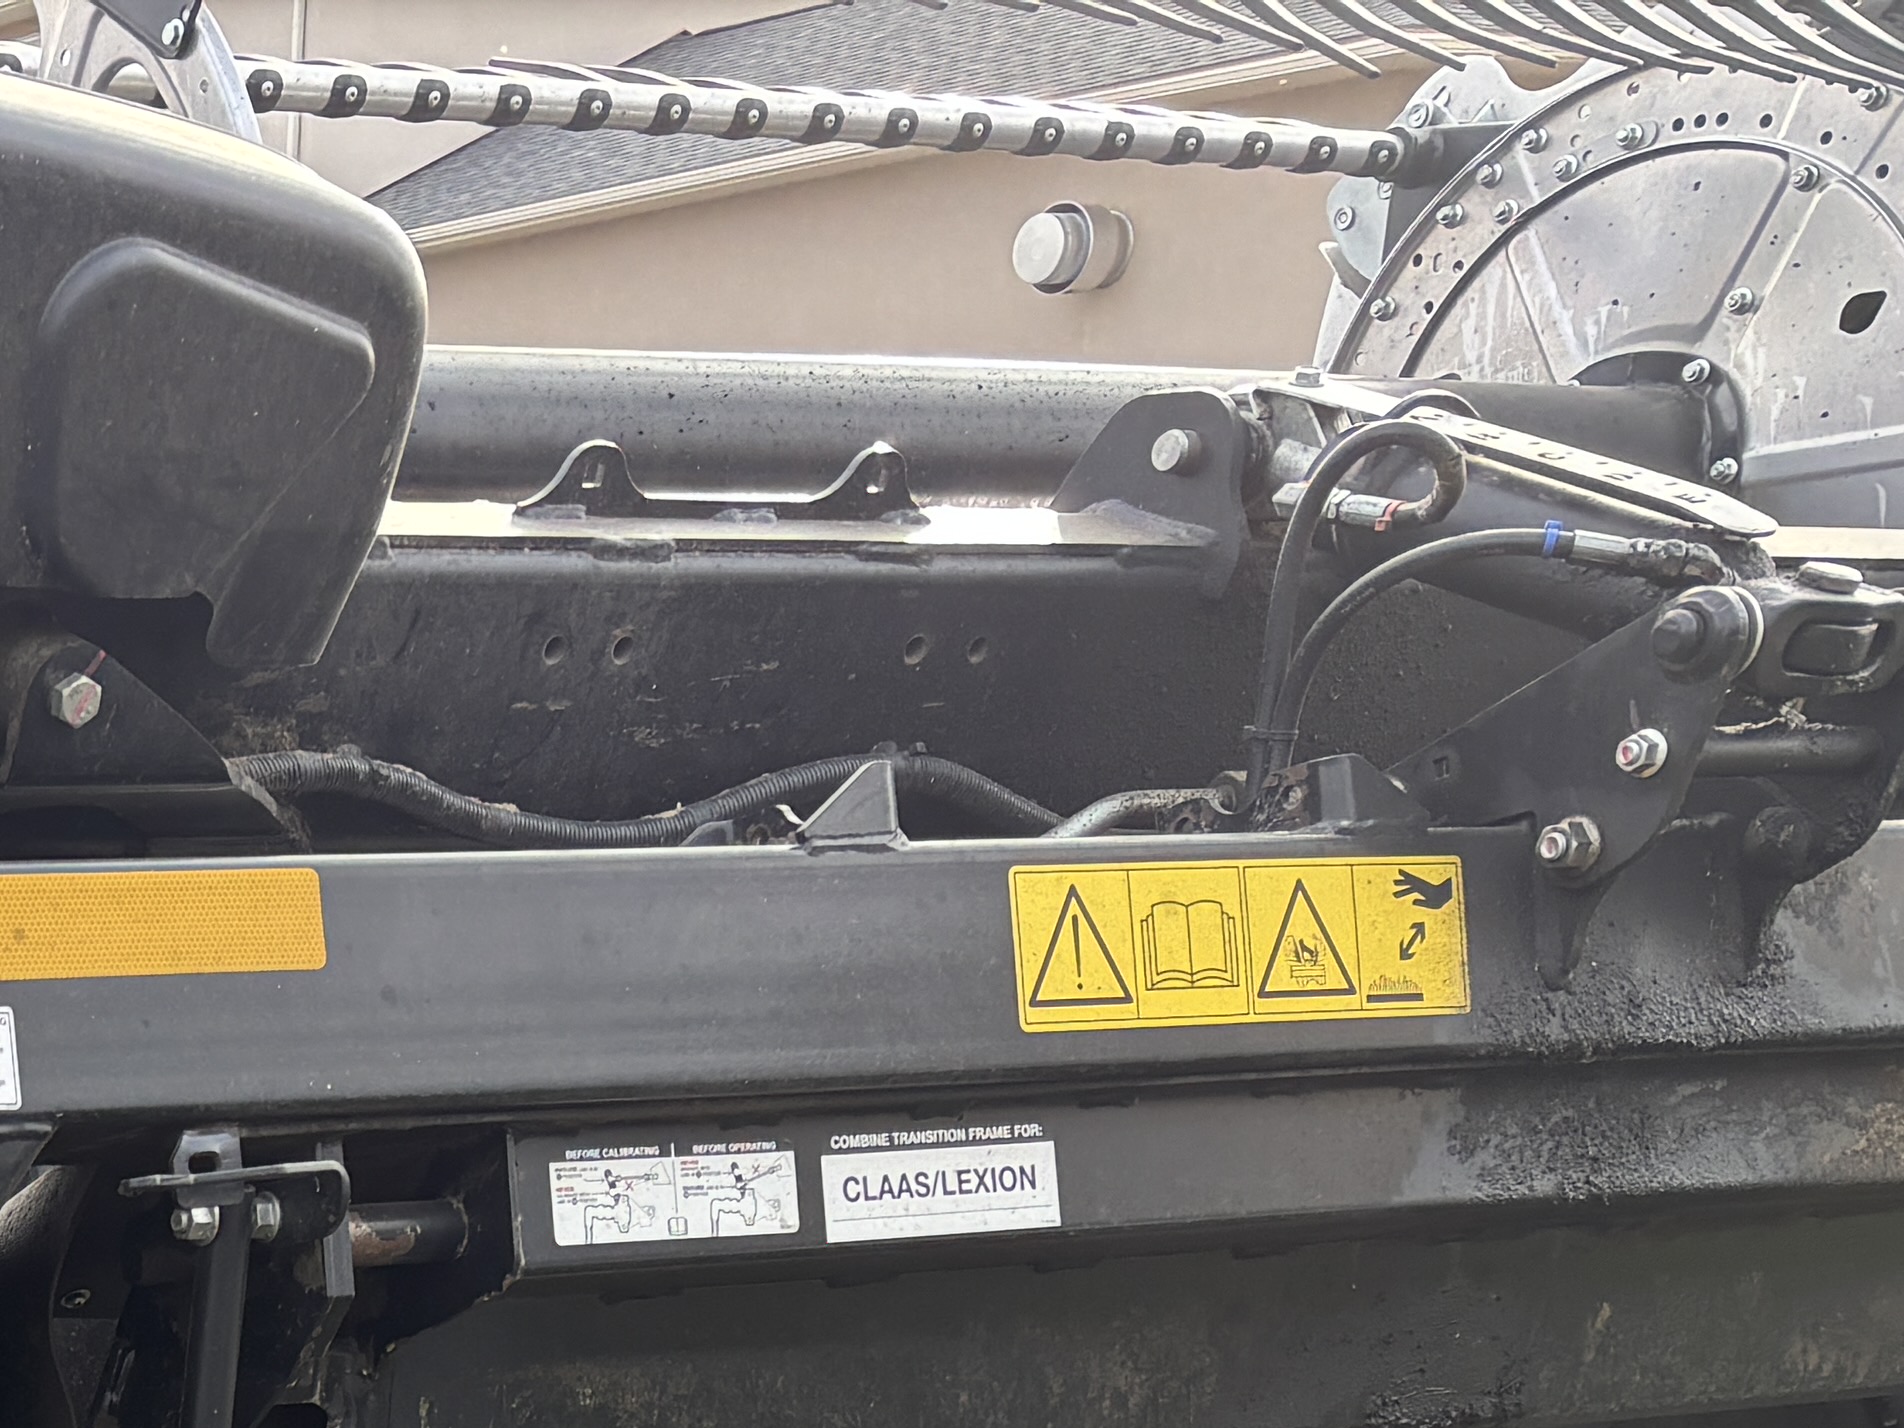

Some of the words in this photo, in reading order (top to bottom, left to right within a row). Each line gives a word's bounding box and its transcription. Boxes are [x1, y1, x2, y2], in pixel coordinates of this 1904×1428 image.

[830, 1132, 889, 1149] COMBINE
[892, 1128, 965, 1146] TRANSITION
[968, 1126, 1011, 1142] FRAME
[1014, 1124, 1043, 1139] FOR:
[566, 1147, 601, 1161] BEFORE
[693, 1142, 727, 1155] BEFORE
[728, 1139, 777, 1153] OPERATING
[842, 1164, 1037, 1202] CLAAS/LEXION
